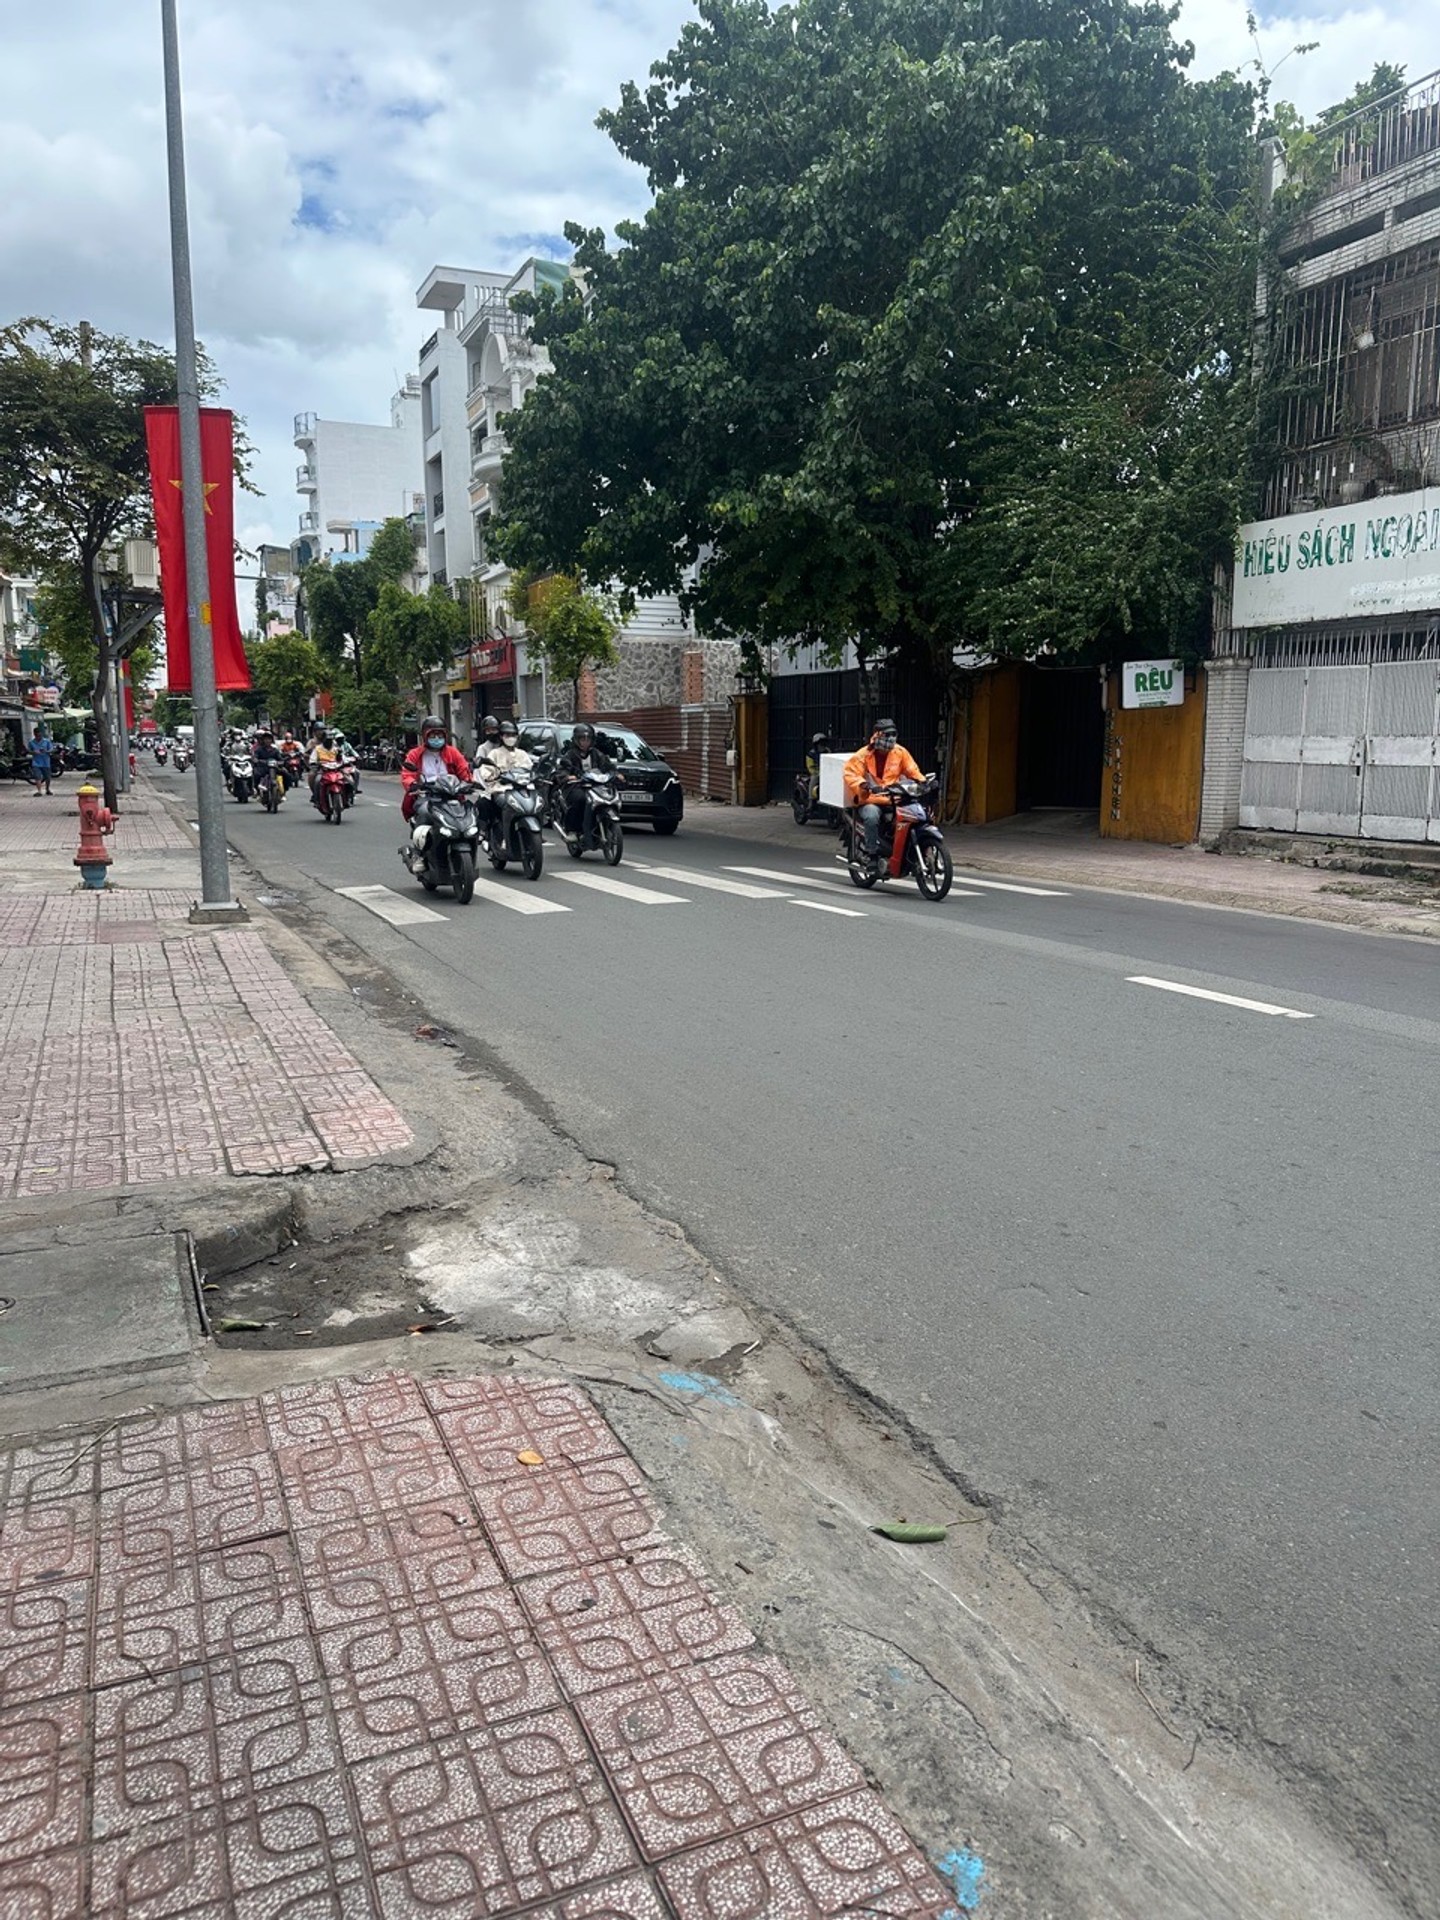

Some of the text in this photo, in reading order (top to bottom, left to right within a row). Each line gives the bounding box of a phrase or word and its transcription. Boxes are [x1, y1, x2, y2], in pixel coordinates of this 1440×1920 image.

[1243, 527, 1292, 584] HIỆU
[1296, 517, 1356, 570] SÁCH
[1135, 667, 1173, 693] RÊU
